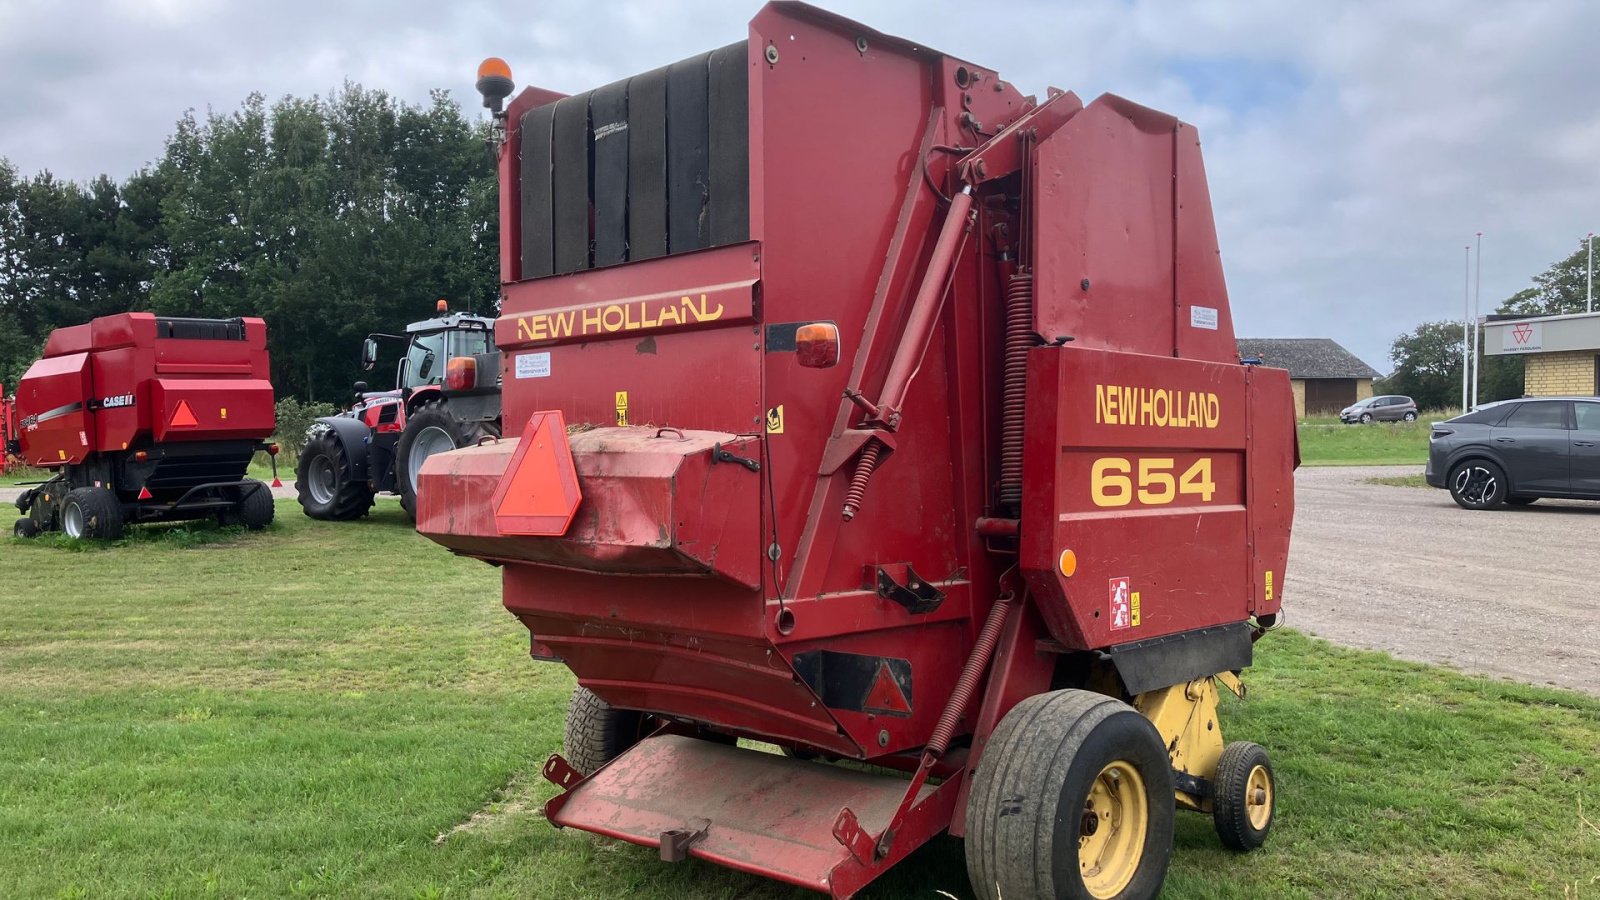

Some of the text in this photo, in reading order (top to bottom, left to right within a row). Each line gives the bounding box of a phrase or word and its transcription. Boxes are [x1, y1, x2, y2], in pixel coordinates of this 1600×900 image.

[518, 294, 723, 340] NEW HOLLAND
[103, 395, 125, 408] CASE
[1096, 384, 1219, 428] NEW HOLLAND
[1091, 457, 1216, 507] 654
